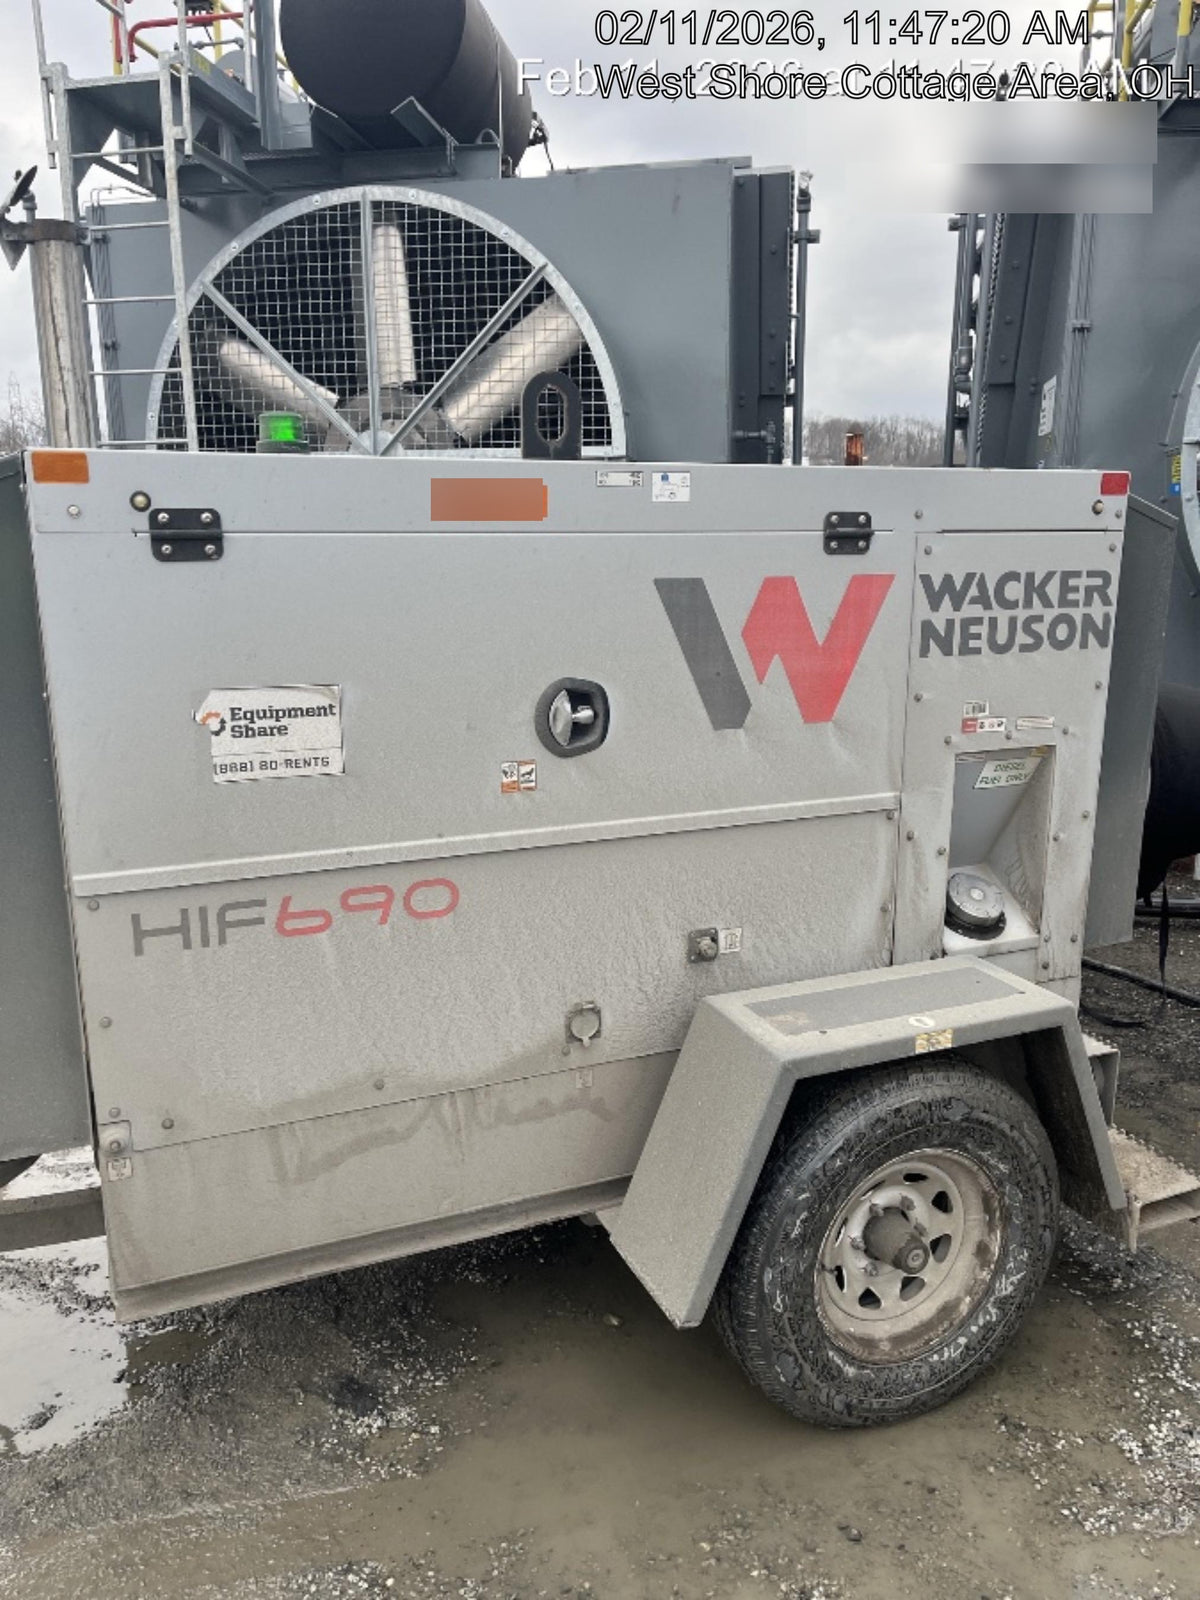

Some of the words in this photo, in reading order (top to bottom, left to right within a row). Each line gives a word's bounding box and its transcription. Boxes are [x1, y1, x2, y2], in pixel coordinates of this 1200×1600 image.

[919, 570, 1113, 612] WACKER
[919, 612, 1112, 658] NEUSON
[229, 703, 337, 724] Equipment
[230, 724, 290, 738] Share
[131, 877, 460, 957] HIF690
